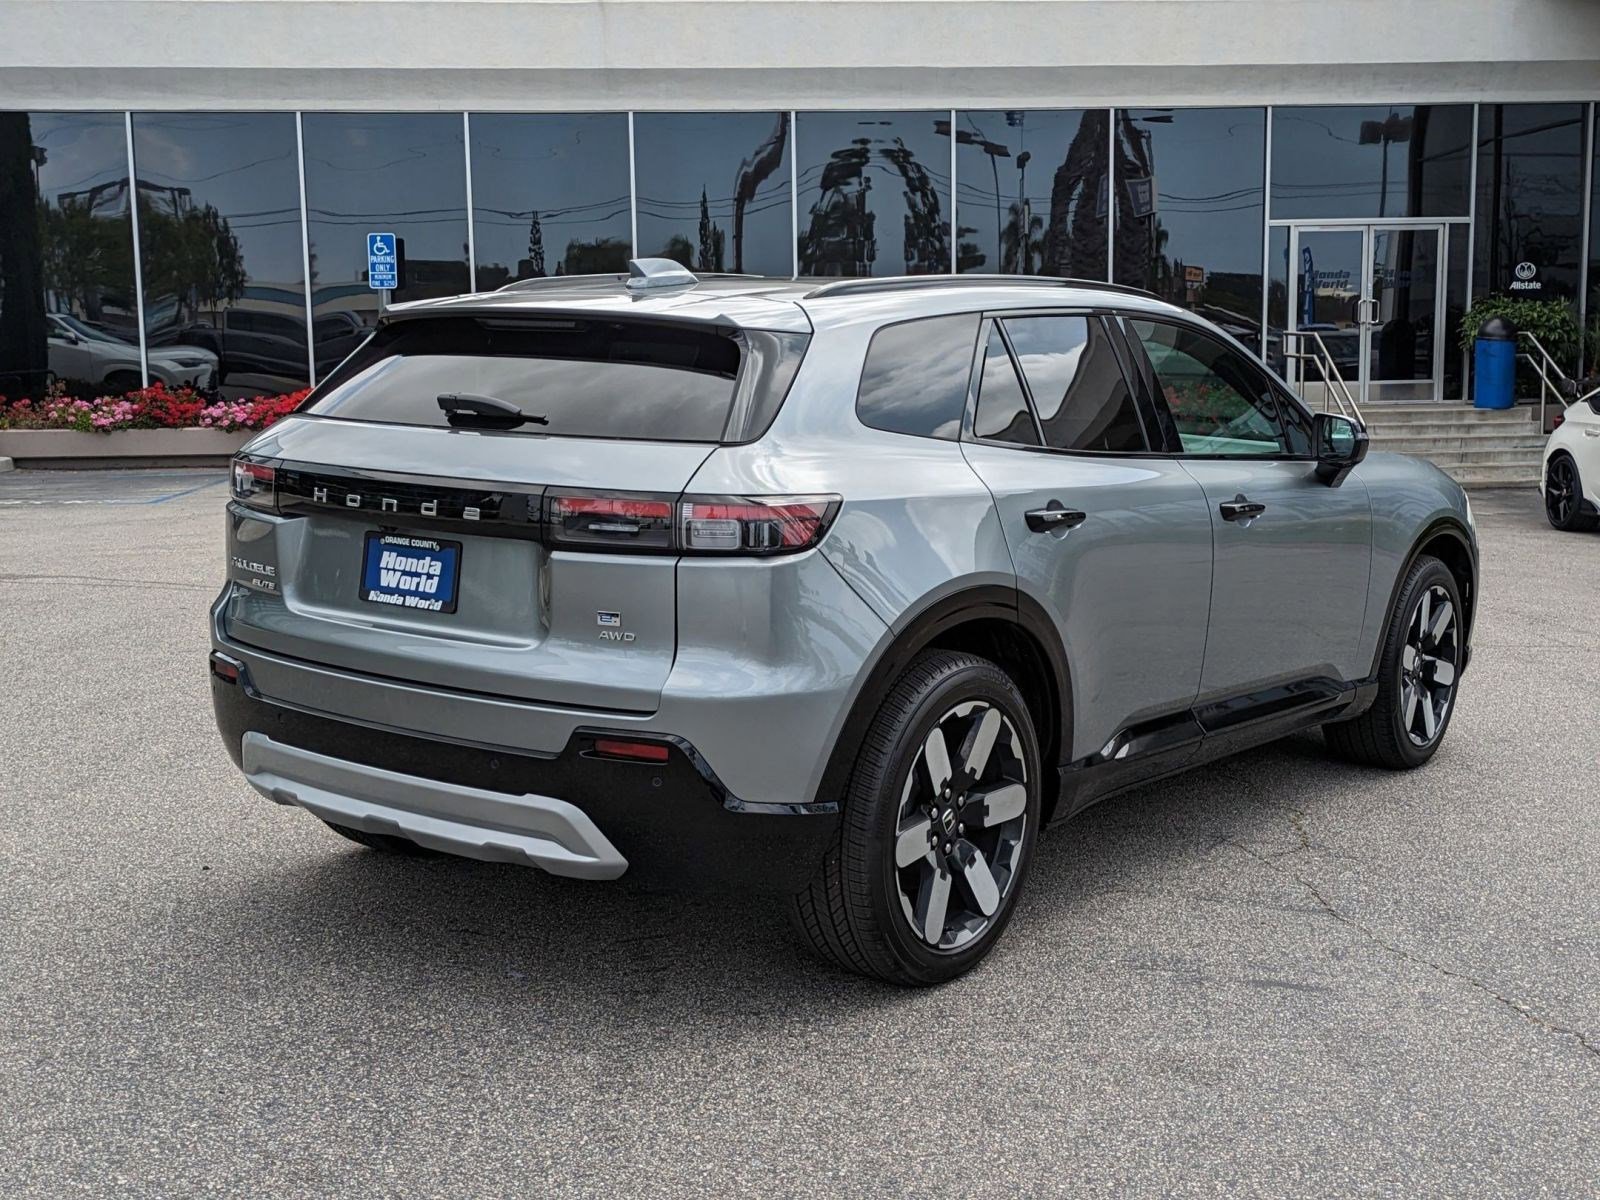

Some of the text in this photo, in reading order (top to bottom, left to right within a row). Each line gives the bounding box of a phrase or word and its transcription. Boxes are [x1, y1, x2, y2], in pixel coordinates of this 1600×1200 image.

[370, 255, 395, 264] PARKING
[375, 264, 390, 272] ONLY
[1509, 281, 1541, 290] Allstate
[384, 536, 437, 549] ORANGE COUNTY
[380, 551, 442, 576] Honda
[252, 578, 275, 590] ELITE
[380, 569, 440, 594] World
[368, 590, 443, 611] Honda World
[599, 630, 635, 641] AWD
